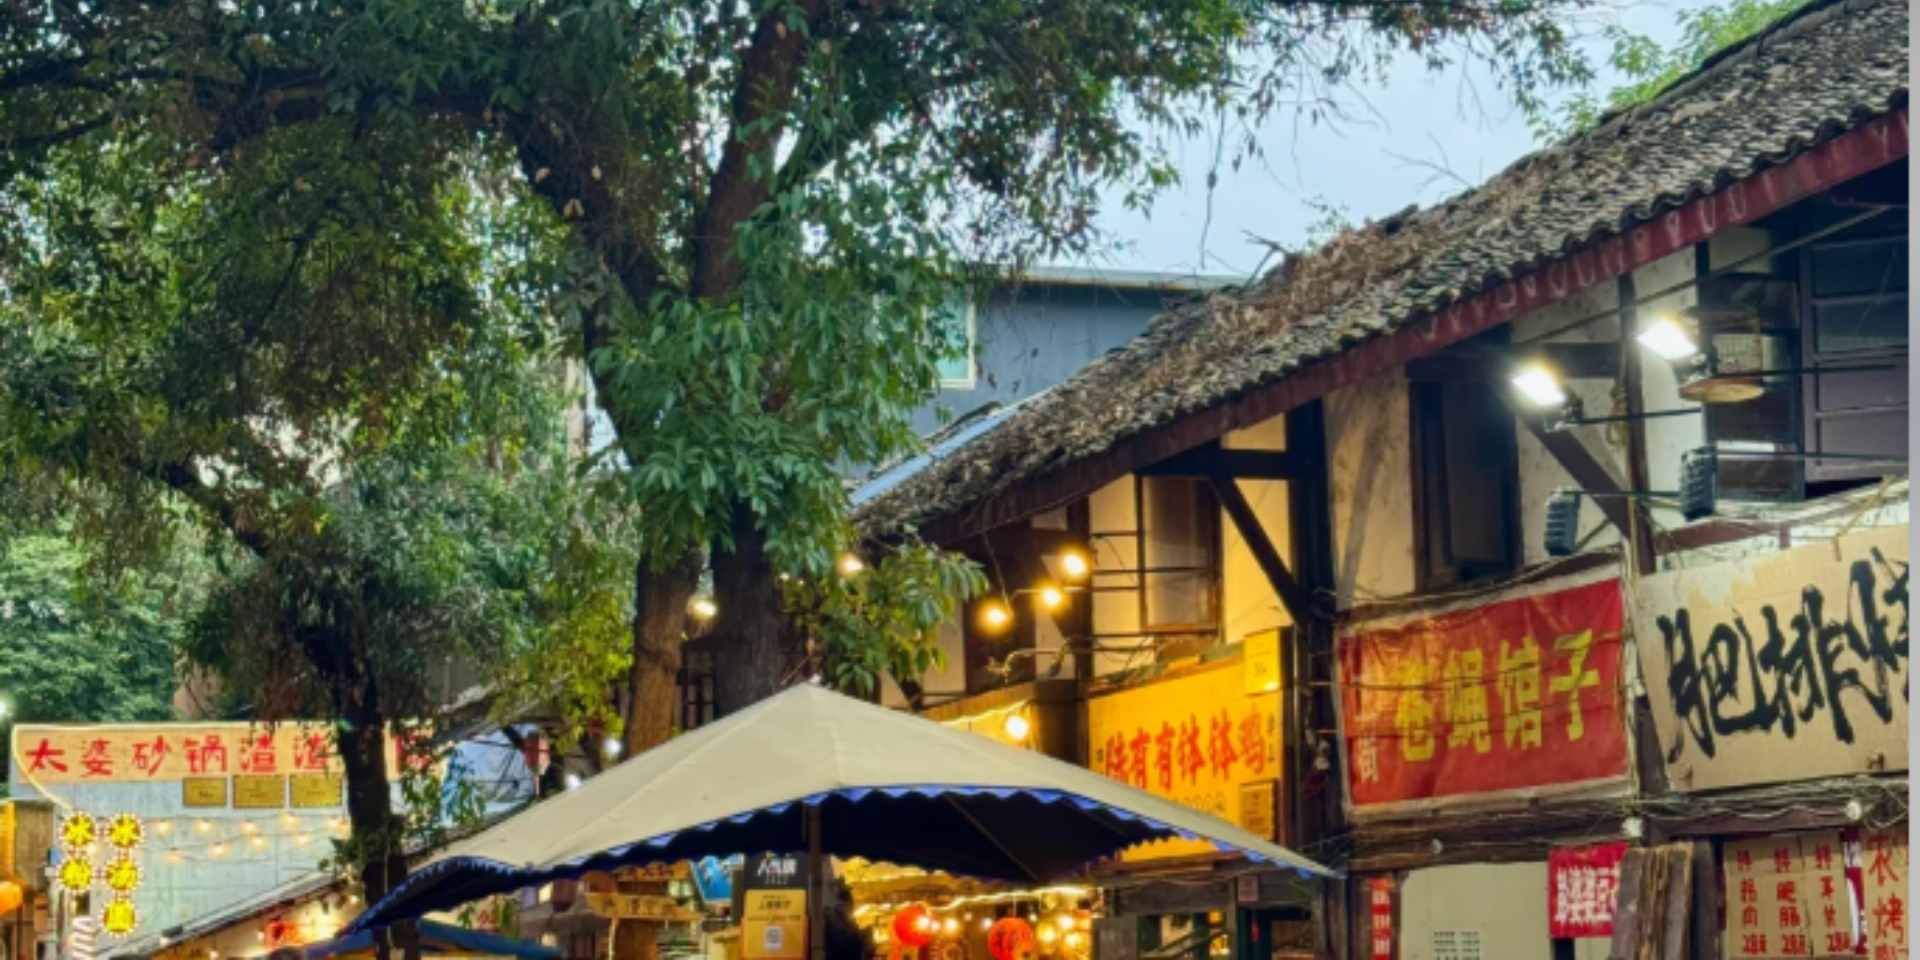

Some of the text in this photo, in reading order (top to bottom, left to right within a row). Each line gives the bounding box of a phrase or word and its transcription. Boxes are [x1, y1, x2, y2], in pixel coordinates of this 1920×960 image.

[1393, 628, 1599, 762] 苍蝇馆子
[25, 734, 431, 777] 太婆砂锅渣渣
